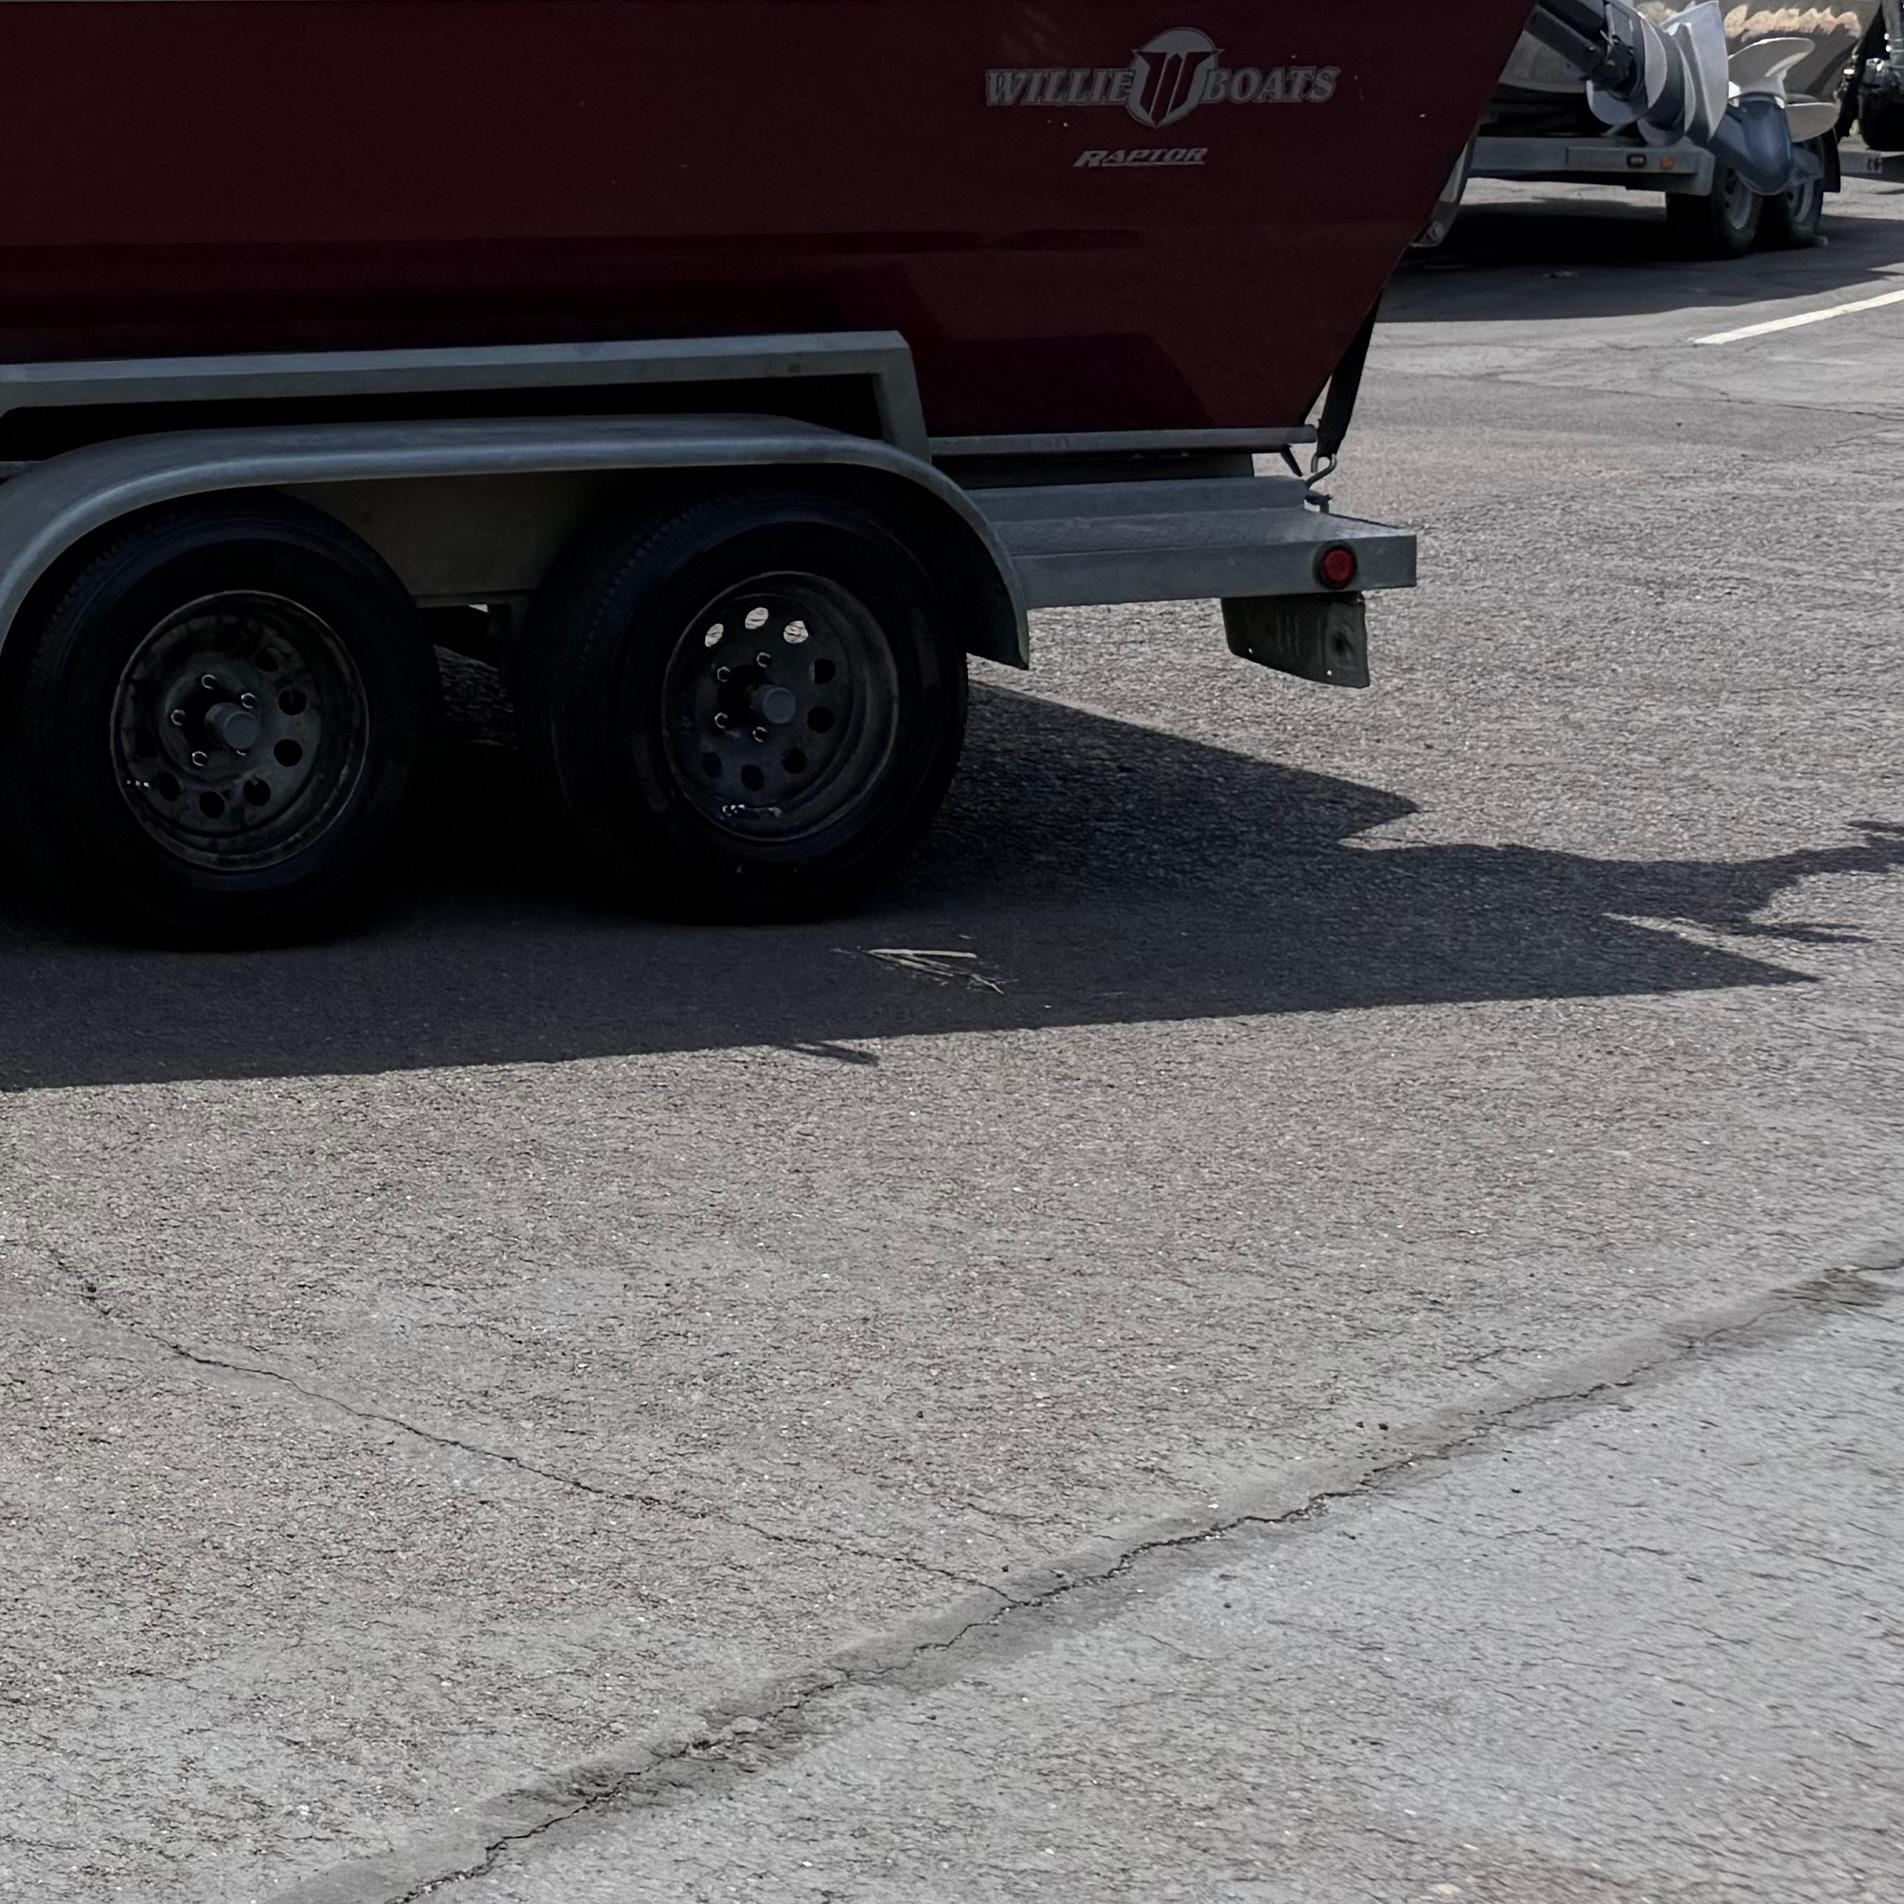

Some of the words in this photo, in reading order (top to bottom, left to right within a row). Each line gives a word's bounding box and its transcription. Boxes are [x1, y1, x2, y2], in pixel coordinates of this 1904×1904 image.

[985, 68, 1136, 106] WILLIE
[1198, 65, 1341, 104] BOATS
[1072, 148, 1208, 167] RAPTOR
